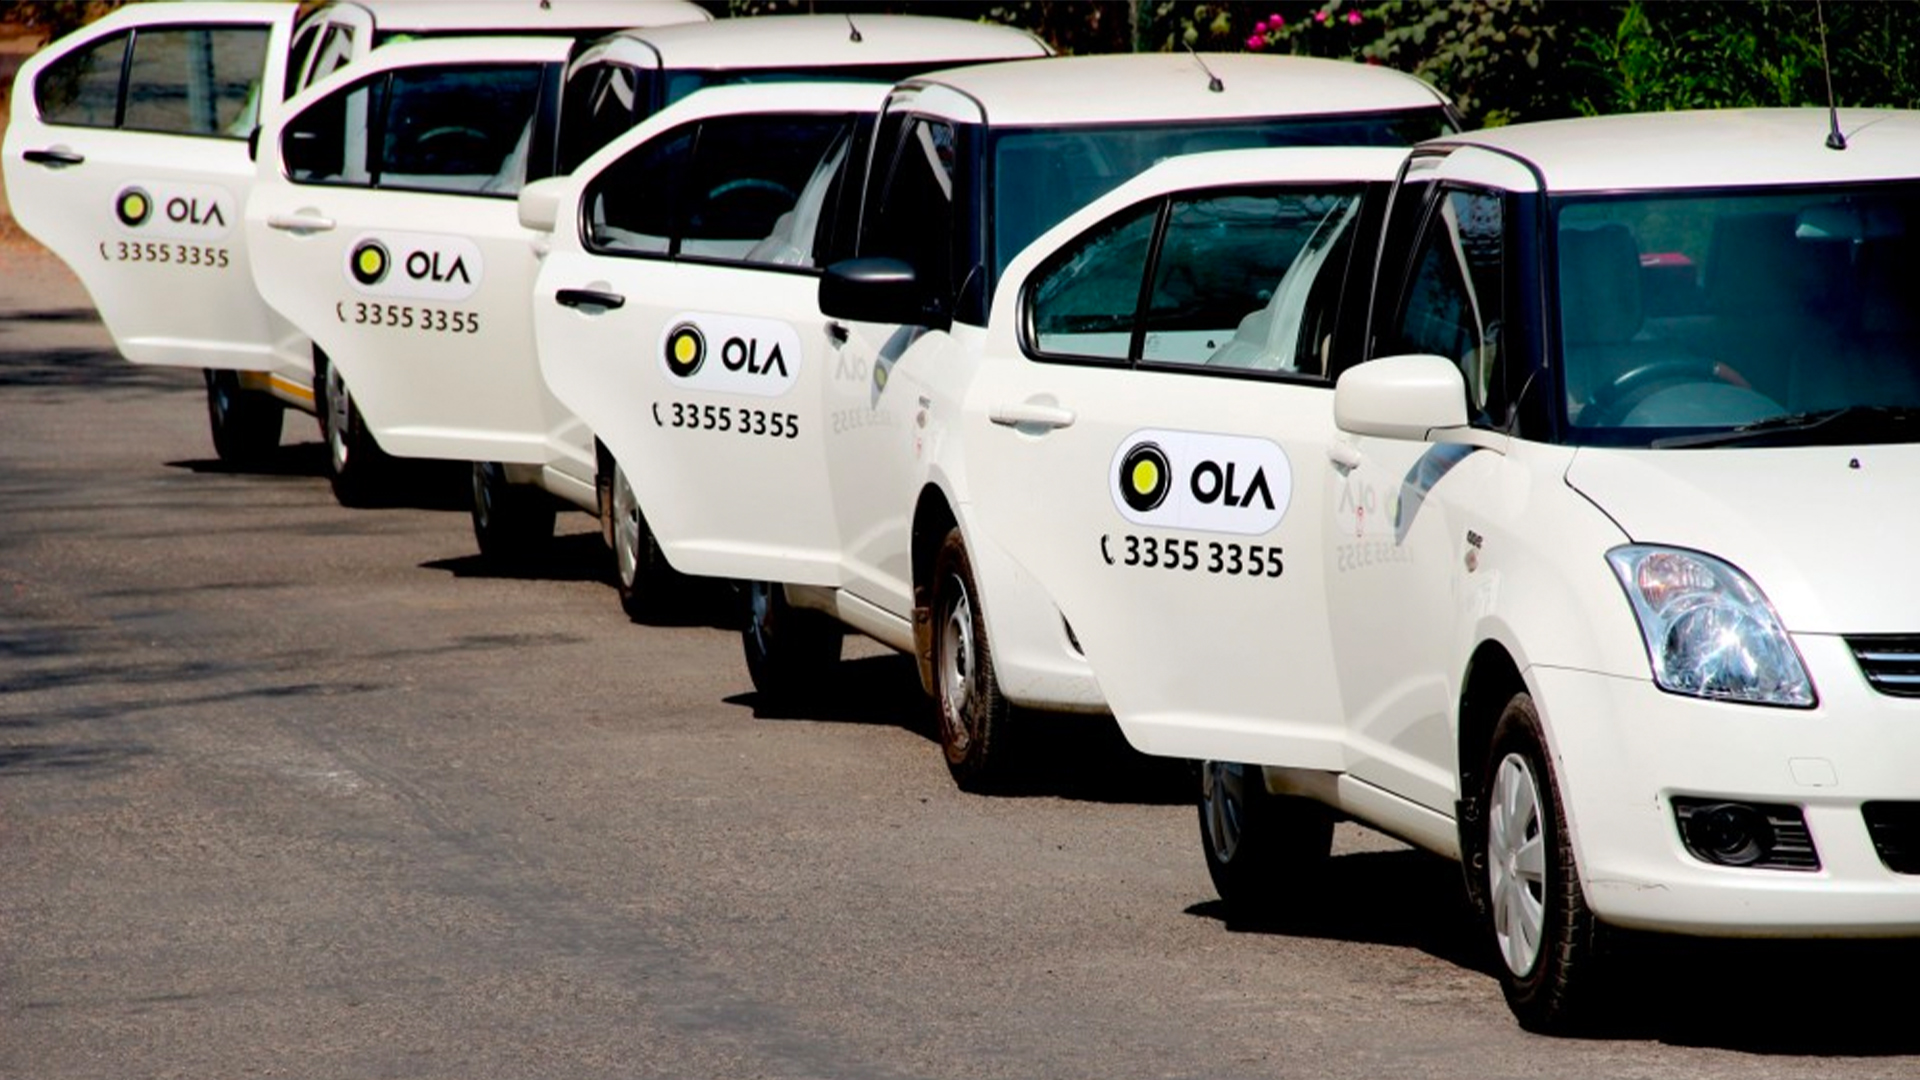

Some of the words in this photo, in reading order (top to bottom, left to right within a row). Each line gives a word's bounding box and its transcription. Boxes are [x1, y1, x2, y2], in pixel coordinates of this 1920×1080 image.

[166, 197, 225, 227] OLA
[117, 241, 171, 262] 3355
[176, 245, 229, 268] 3355
[405, 250, 471, 284] OLA
[355, 302, 414, 328] 3355
[420, 308, 479, 334] 3355
[721, 336, 788, 378] OLA
[671, 402, 732, 432] 3355
[738, 408, 799, 439] 3355
[1189, 460, 1276, 511] OLA
[1124, 534, 1199, 572] 3355
[1207, 541, 1284, 579] 3355
